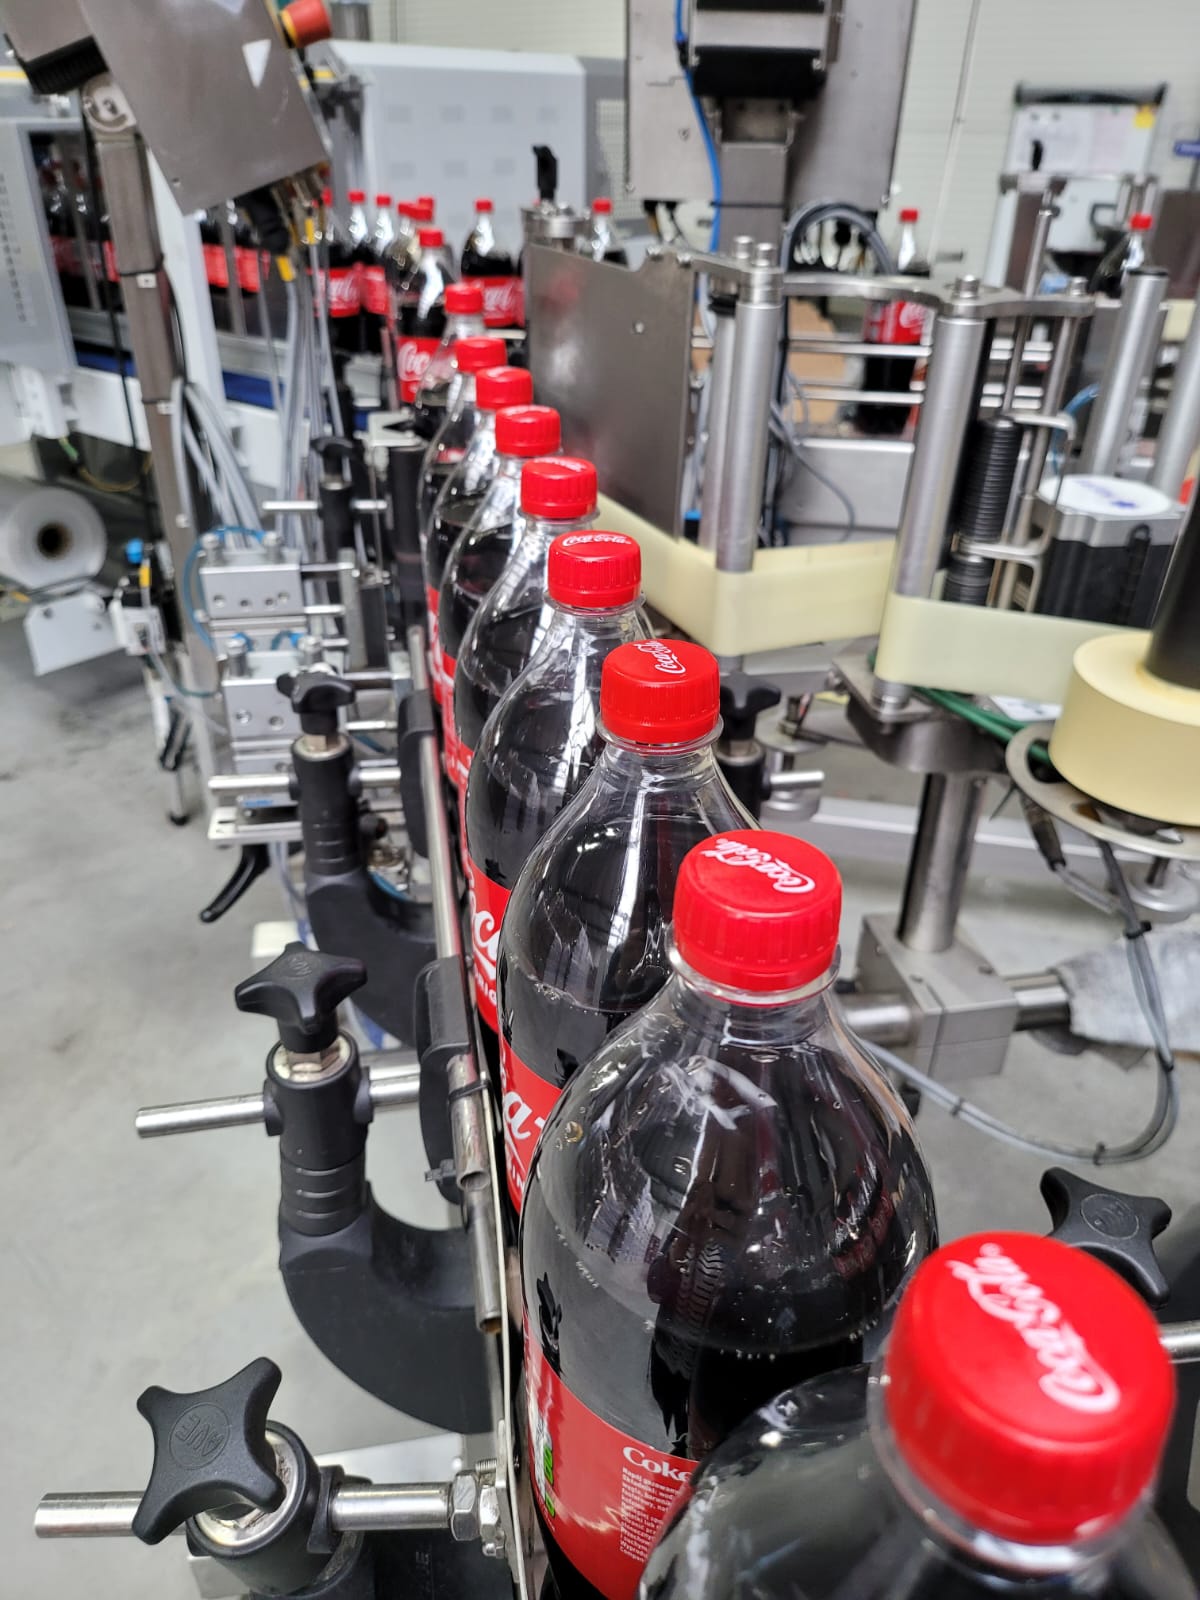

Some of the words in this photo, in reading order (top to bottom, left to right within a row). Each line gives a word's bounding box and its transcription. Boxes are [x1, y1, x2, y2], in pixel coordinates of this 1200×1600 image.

[632, 640, 687, 674] Coca-Cola
[699, 837, 816, 894] Coca-Cola
[945, 1241, 1122, 1415] Coca-Cola
[622, 1446, 692, 1482] Coke
